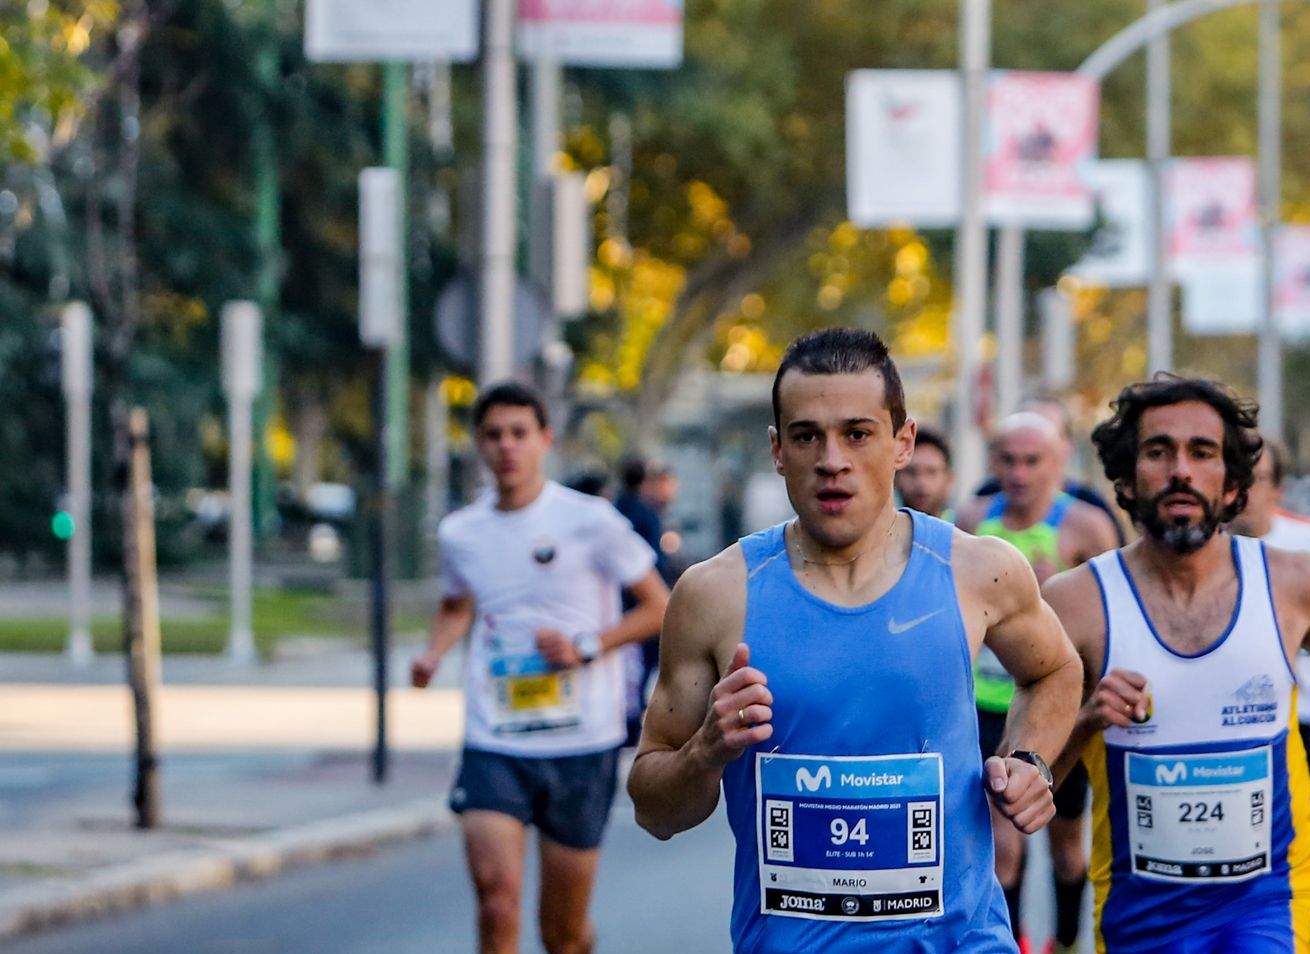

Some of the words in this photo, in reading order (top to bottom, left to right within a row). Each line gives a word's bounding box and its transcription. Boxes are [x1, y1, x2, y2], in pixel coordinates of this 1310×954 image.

[1192, 766, 1244, 778] Movistar
[841, 773, 904, 787] Movistar
[1179, 801, 1224, 823] 224
[830, 818, 869, 845] 94
[832, 878, 867, 887] MARIO
[887, 897, 932, 910] MADRID
